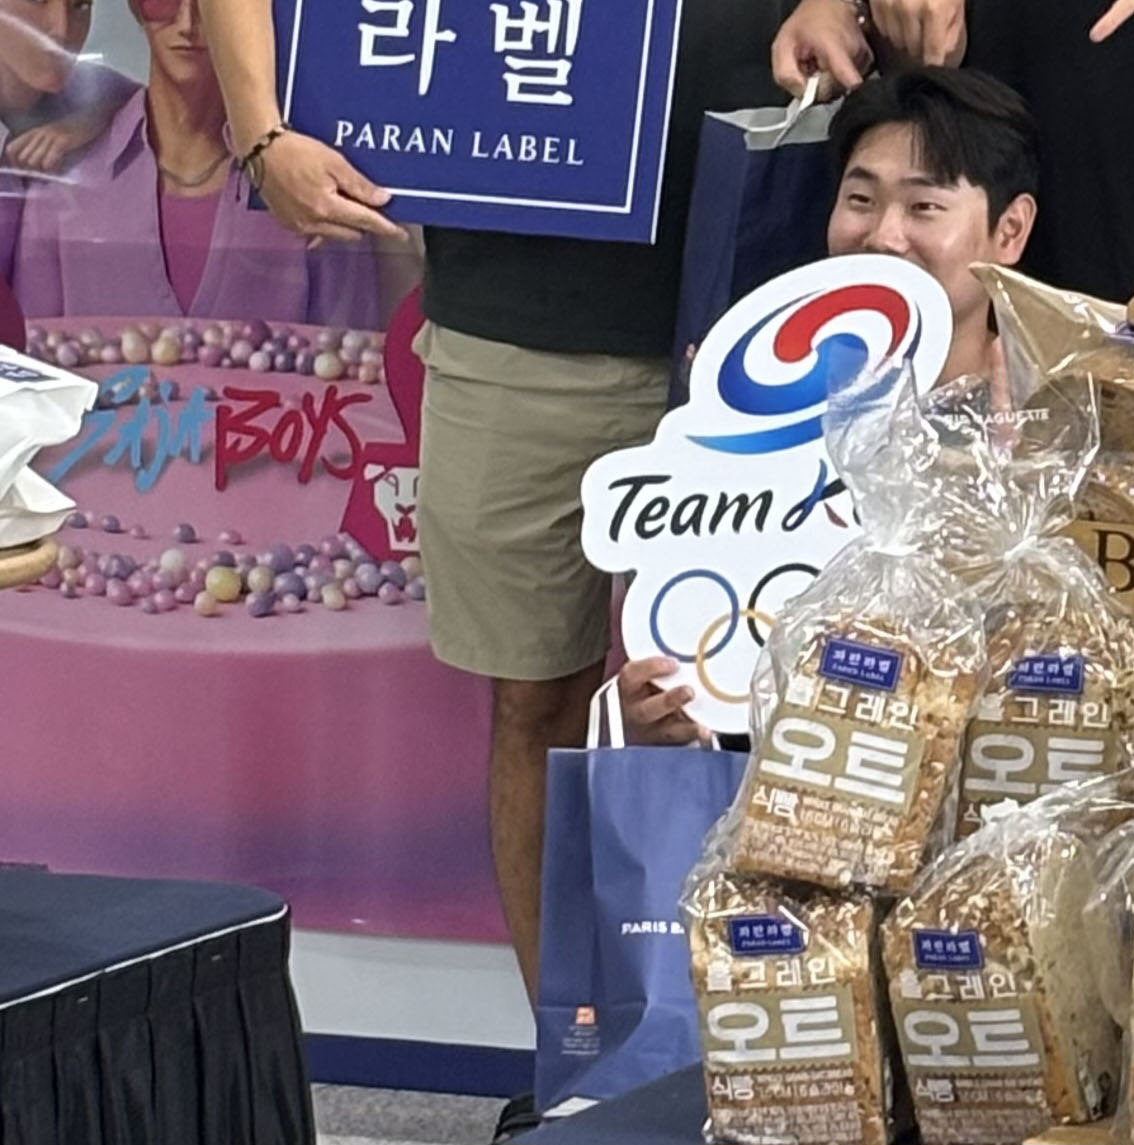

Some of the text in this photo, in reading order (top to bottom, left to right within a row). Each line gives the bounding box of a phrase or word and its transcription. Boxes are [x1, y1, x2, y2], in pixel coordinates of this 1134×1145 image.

[334, 119, 584, 165] PARAN LABEL
[608, 473, 774, 543] Team
[760, 717, 909, 803] 오트
[621, 920, 667, 935] PARIS
[707, 996, 851, 1062] 오트
[904, 1010, 1039, 1067] 오트
